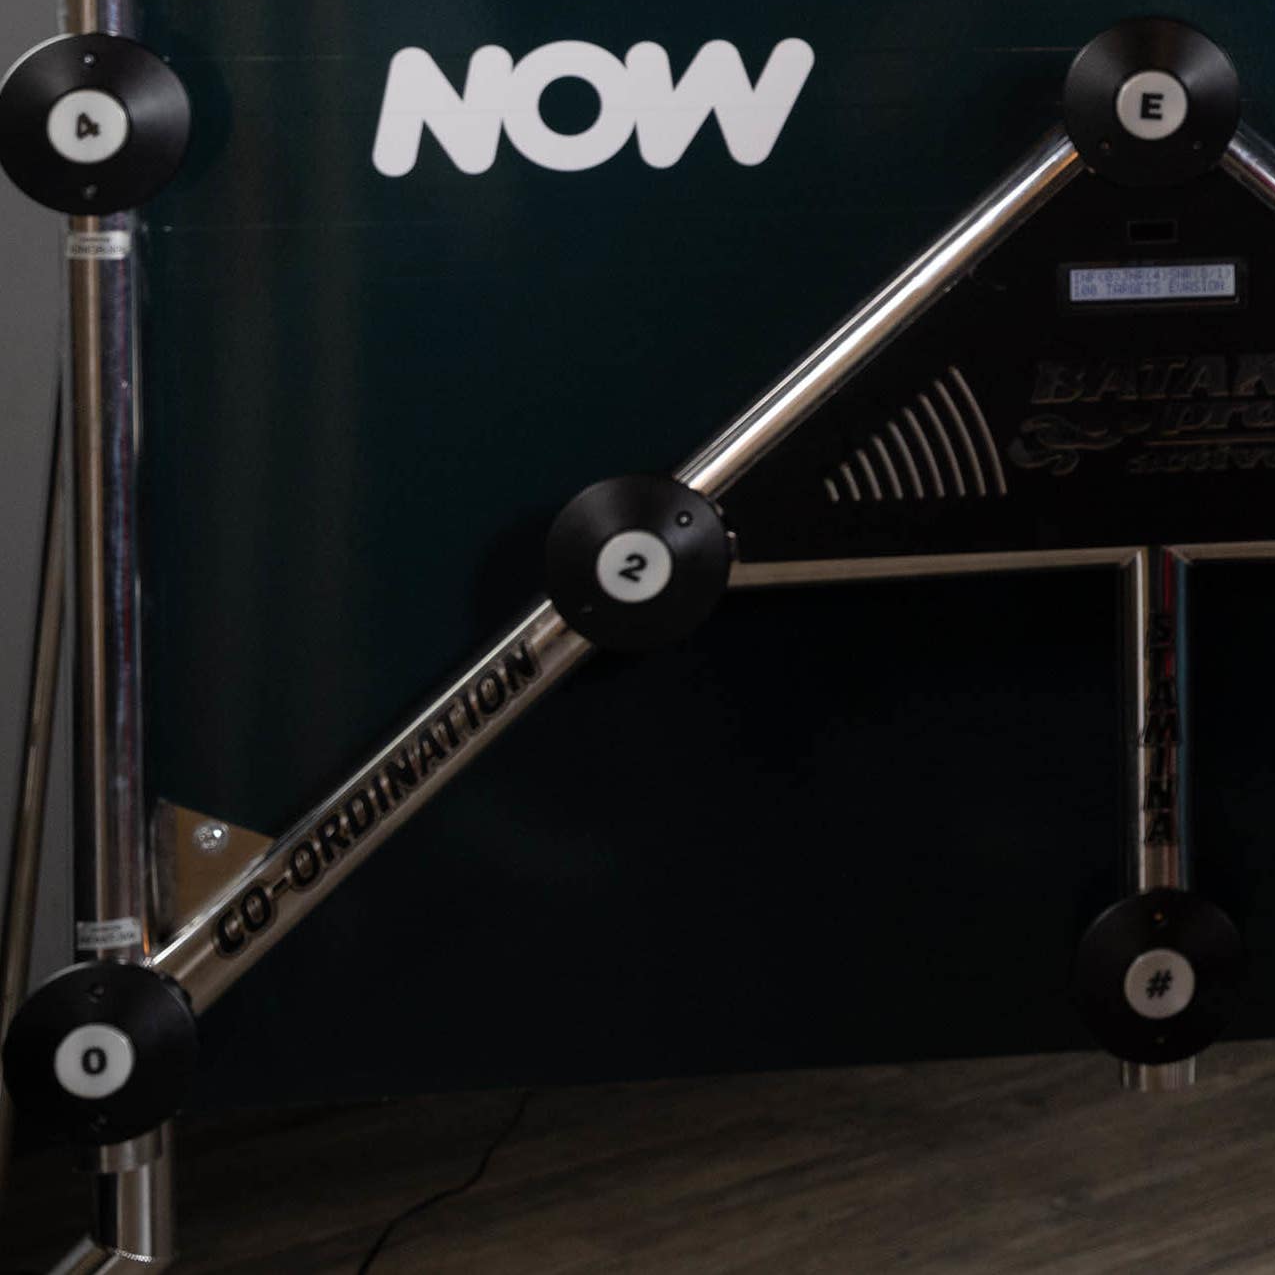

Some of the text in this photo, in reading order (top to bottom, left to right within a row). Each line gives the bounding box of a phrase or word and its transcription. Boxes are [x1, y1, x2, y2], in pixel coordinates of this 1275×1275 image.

[371, 38, 816, 178] NOW
[1140, 94, 1164, 120] E
[75, 113, 101, 141] 4
[618, 553, 648, 582] 2
[213, 639, 540, 955] CO-ORDINATION
